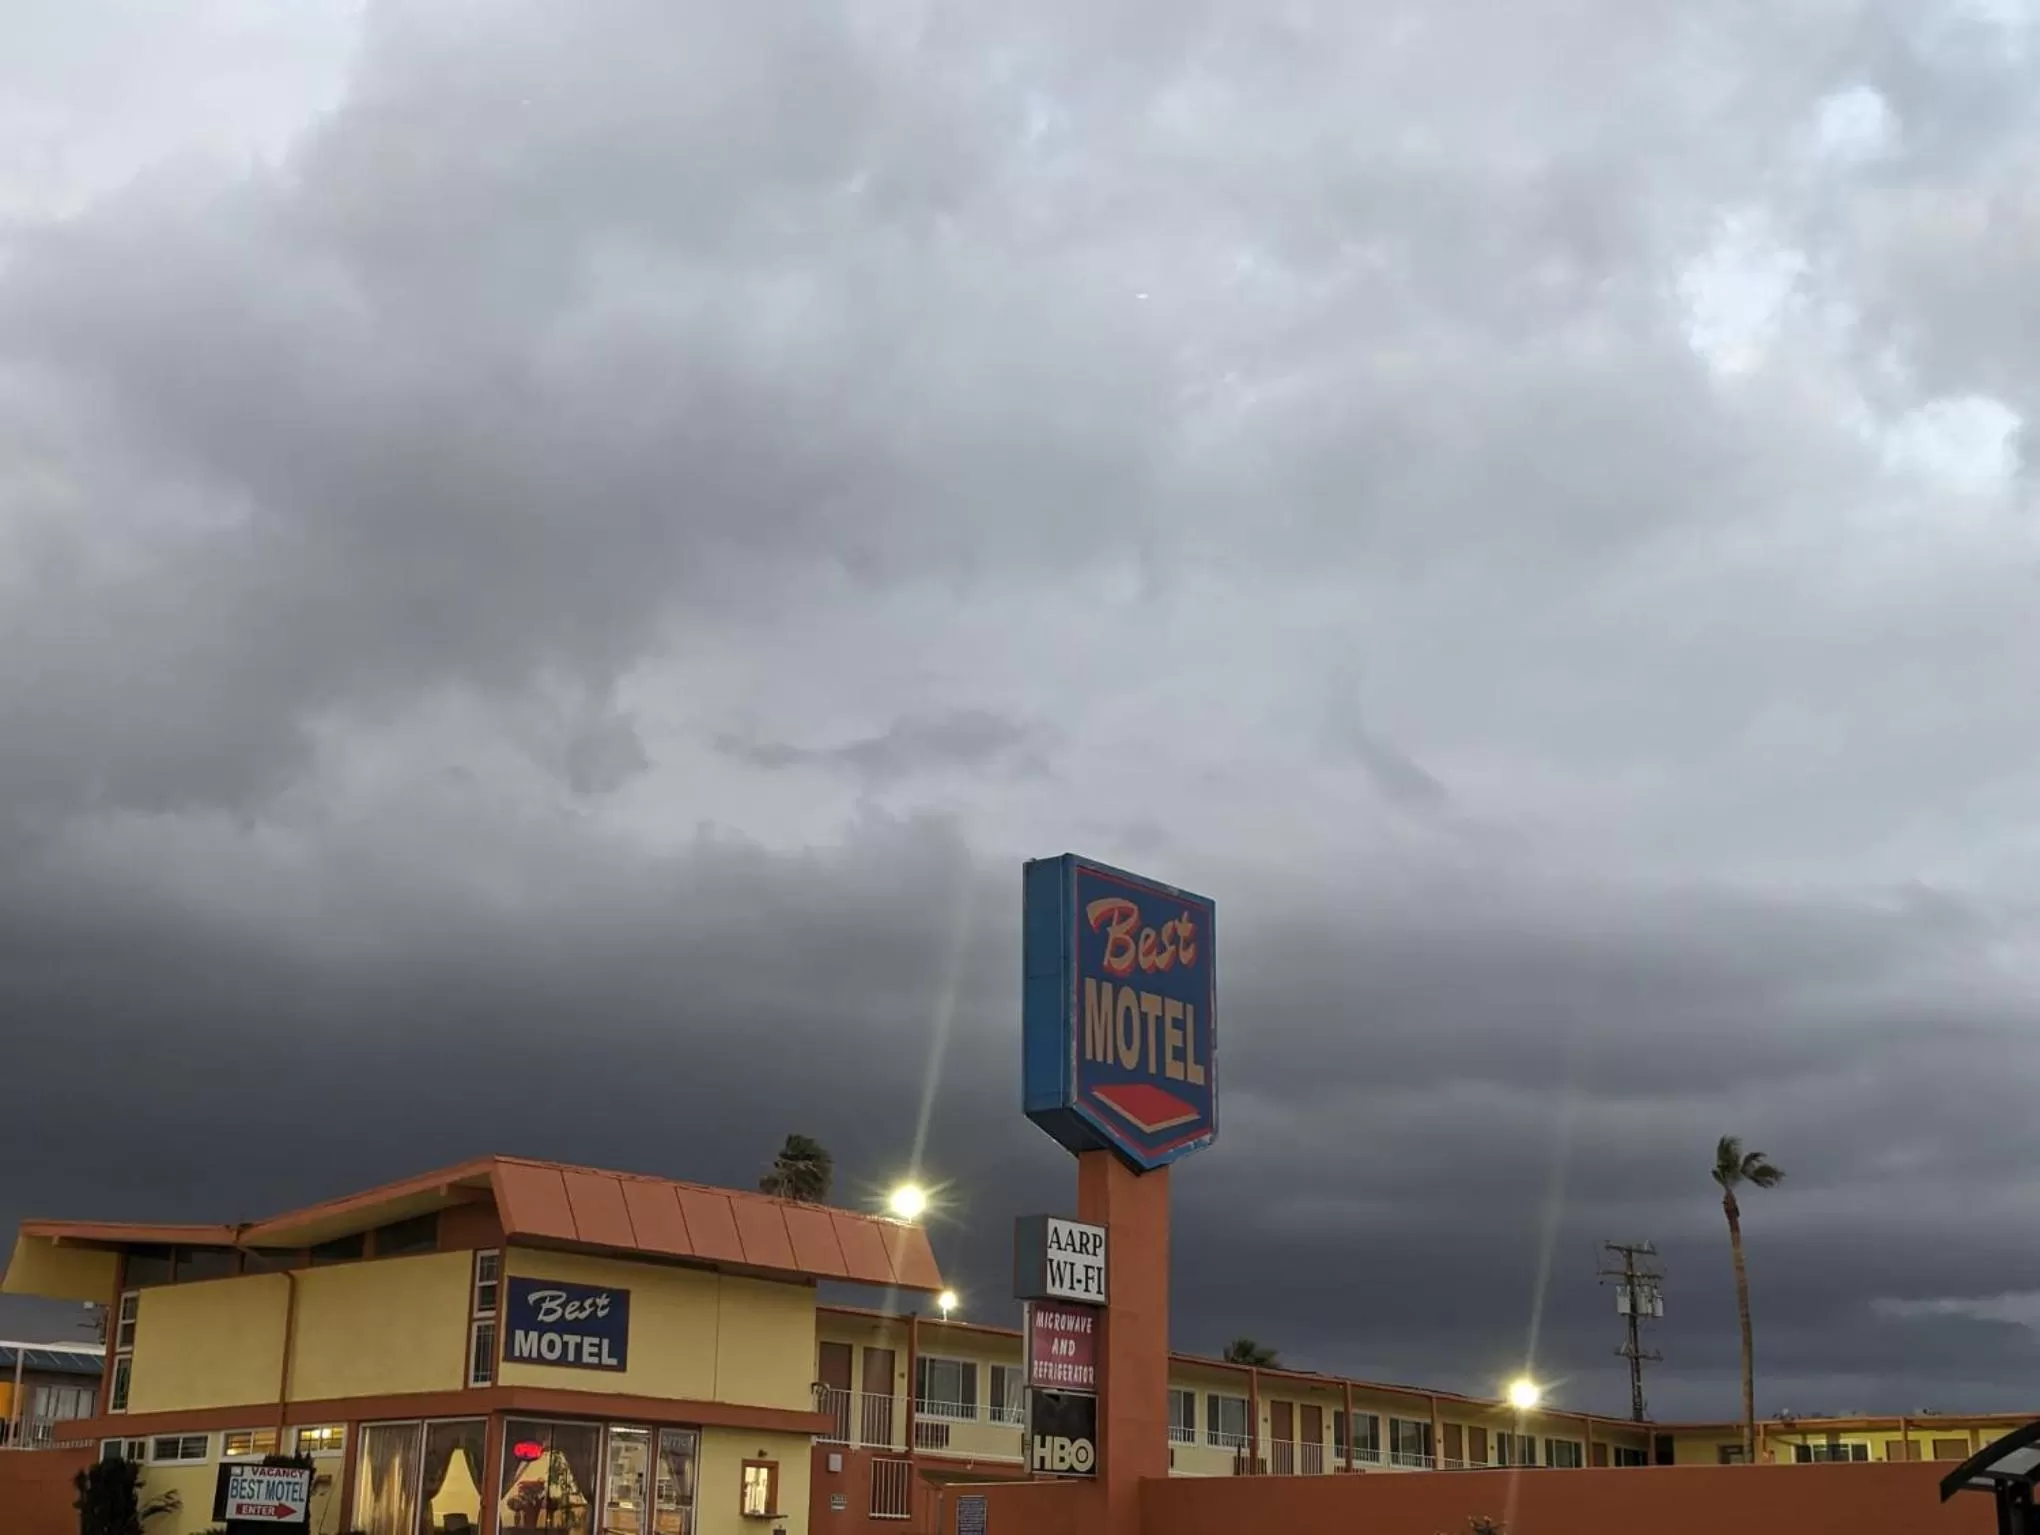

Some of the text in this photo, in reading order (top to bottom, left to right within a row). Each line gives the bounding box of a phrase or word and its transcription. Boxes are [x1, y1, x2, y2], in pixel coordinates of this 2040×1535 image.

[1086, 897, 1197, 977] Best
[1084, 976, 1205, 1086] MOTEL
[1048, 1225, 1103, 1257] AARP
[1047, 1258, 1104, 1295] WI-FI
[527, 1289, 610, 1323] Best
[1035, 1309, 1093, 1334] MICROWAVE
[513, 1329, 618, 1366] MOTEL
[1051, 1337, 1077, 1357] AND
[1033, 1359, 1095, 1385] REFRIGERATOR
[1032, 1434, 1095, 1472] HBO
[251, 1465, 306, 1479] VACANCY
[230, 1478, 305, 1503] BEST MOTEL
[241, 1505, 275, 1517] ENTER
